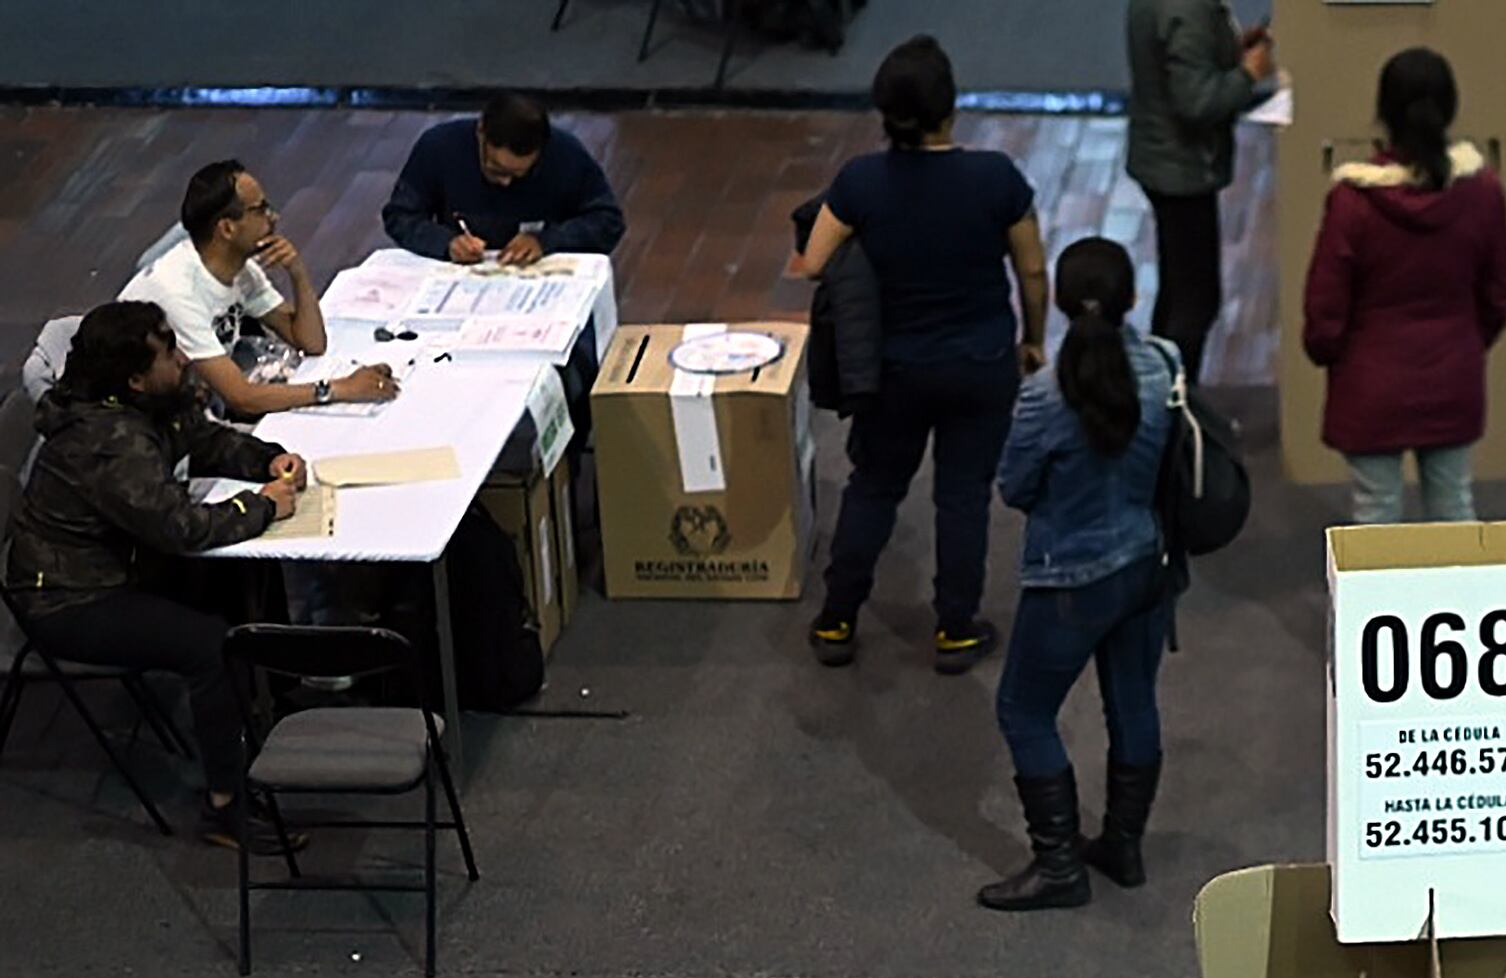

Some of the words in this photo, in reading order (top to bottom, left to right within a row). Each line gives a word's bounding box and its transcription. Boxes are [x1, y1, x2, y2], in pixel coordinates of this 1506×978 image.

[1398, 729, 1416, 744] DE
[1421, 728, 1439, 743] LA
[1384, 798, 1431, 813] HASTA
[1435, 797, 1453, 811] LA
